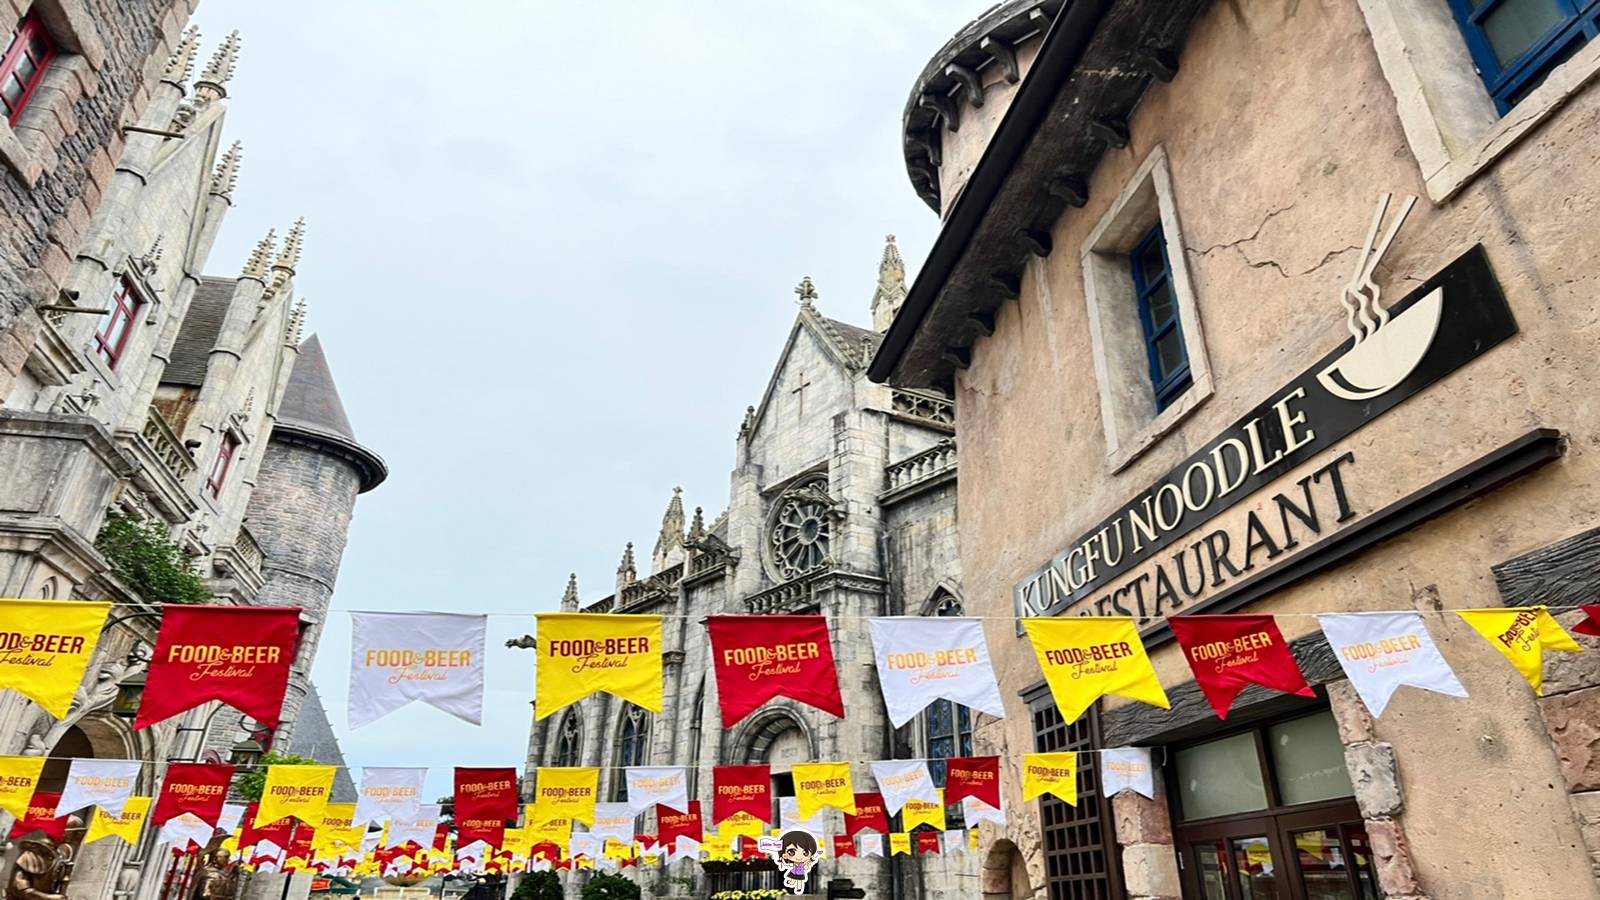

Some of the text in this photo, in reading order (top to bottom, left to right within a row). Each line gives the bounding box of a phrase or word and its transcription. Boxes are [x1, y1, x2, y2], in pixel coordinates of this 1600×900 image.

[1018, 387, 1316, 617] KUNGFU NOODLE
[168, 644, 281, 665] FOOD&BEER
[549, 636, 649, 657] FOOD&BEER
[723, 641, 820, 667] FOOD&BEER
[1045, 641, 1133, 666] FOOD&BEER
[1190, 631, 1273, 662] FOOD&BEER
[1340, 634, 1422, 661] FOOD&BEER
[365, 648, 473, 668] FOOD&BEER
[572, 655, 628, 673] Festival
[887, 648, 978, 671] FOOD&BEER
[1215, 651, 1259, 673] Festival
[189, 662, 254, 681] Festival
[388, 667, 448, 684] Festival
[748, 661, 801, 681] Festival
[1071, 660, 1119, 679] Festival
